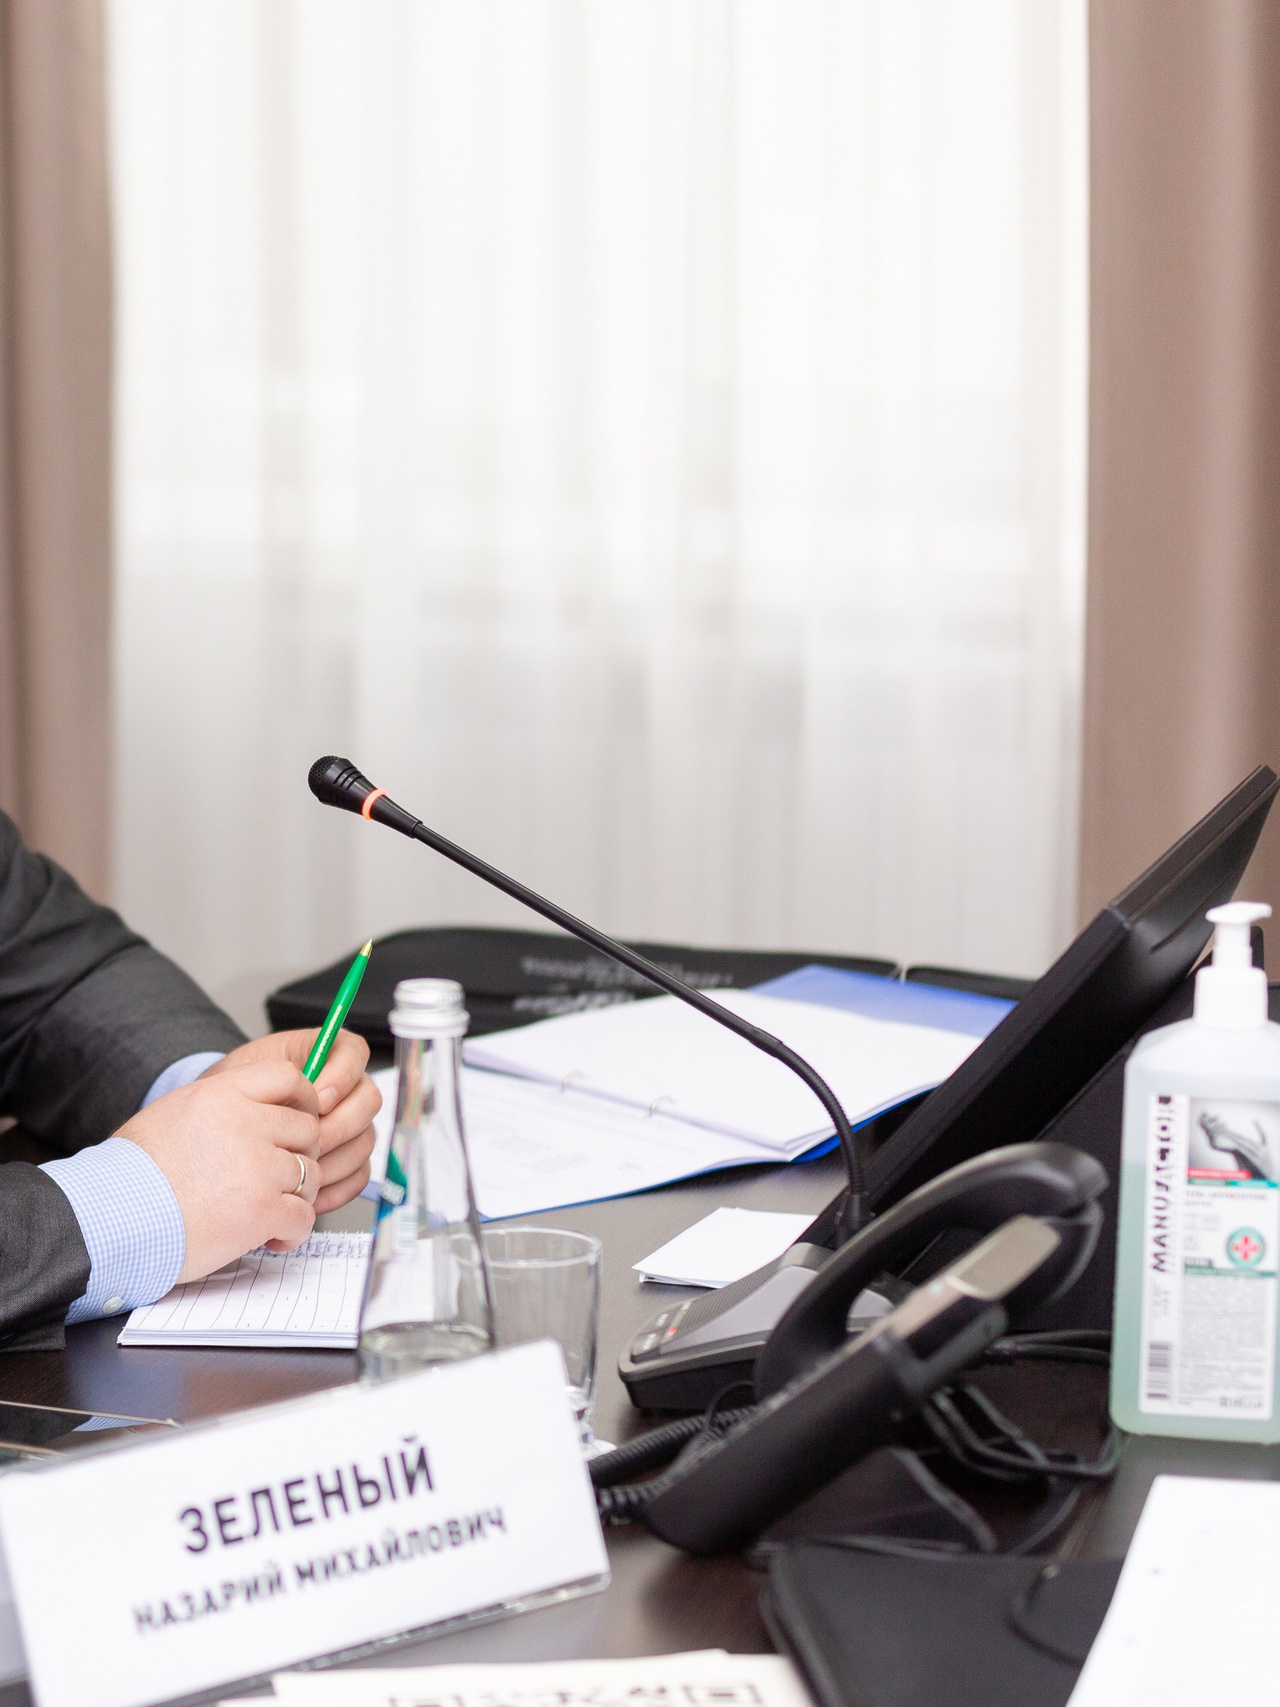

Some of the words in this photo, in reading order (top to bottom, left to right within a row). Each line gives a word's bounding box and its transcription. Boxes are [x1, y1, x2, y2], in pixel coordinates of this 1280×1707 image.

[179, 1434, 434, 1554] ЗЕЛЕНЫЙ
[133, 1560, 286, 1633] НАЗАРИЙ
[294, 1508, 506, 1589] МИХАЙЛОВИЧ
